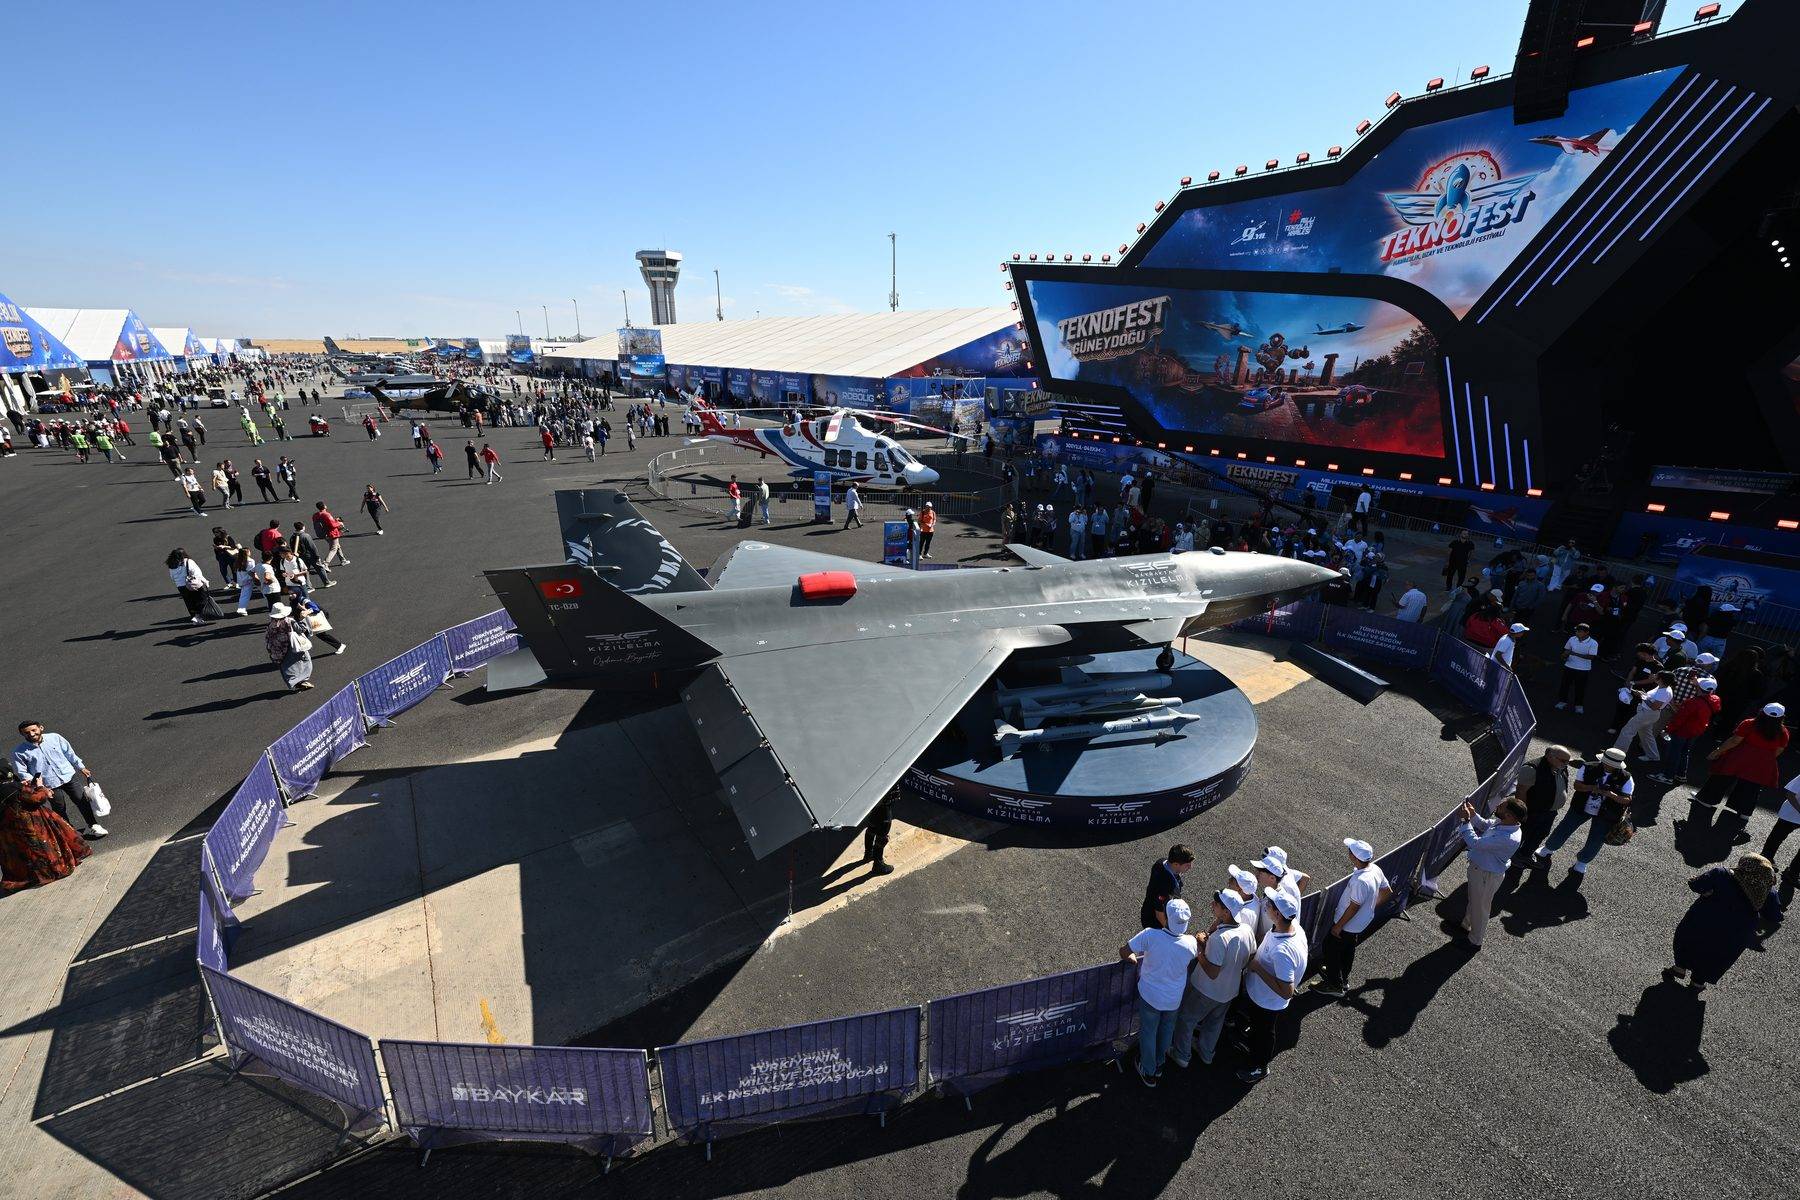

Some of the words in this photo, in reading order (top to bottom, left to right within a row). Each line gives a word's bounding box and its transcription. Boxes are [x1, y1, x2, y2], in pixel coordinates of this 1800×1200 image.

[1380, 190, 1536, 261] TEKNOFEST
[1436, 247, 1444, 255] VE
[1058, 295, 1170, 341] TEKNOFEST
[1073, 329, 1146, 355] GÜNEYDOĞU
[1226, 464, 1298, 483] TEKNOFEST
[455, 653, 465, 661] İLK
[588, 641, 663, 652] KIZILELMA
[392, 674, 432, 700] KIZILELMA
[1455, 663, 1487, 690] BAYKAR
[904, 777, 954, 804] KIZILELMA
[986, 807, 1052, 823] KIZILELMA
[1179, 793, 1222, 815] KIZILELMA
[1088, 815, 1151, 825] KIZILELMA
[993, 1022, 1087, 1051] KIZILELMA
[1010, 1017, 1073, 1037] BAYRAKTAR
[233, 1015, 288, 1048] INDIGENOUS
[290, 1042, 312, 1058] AND
[312, 1053, 359, 1084] ORIGINAL
[243, 1029, 295, 1060] UNMANNED
[297, 1055, 336, 1080] FIGHTER
[336, 1077, 355, 1090] JET
[782, 1069, 800, 1082] VE
[471, 1086, 586, 1106] BAYKAR
[700, 1090, 725, 1105] İLK
[797, 1072, 842, 1088] SAVAŞ
